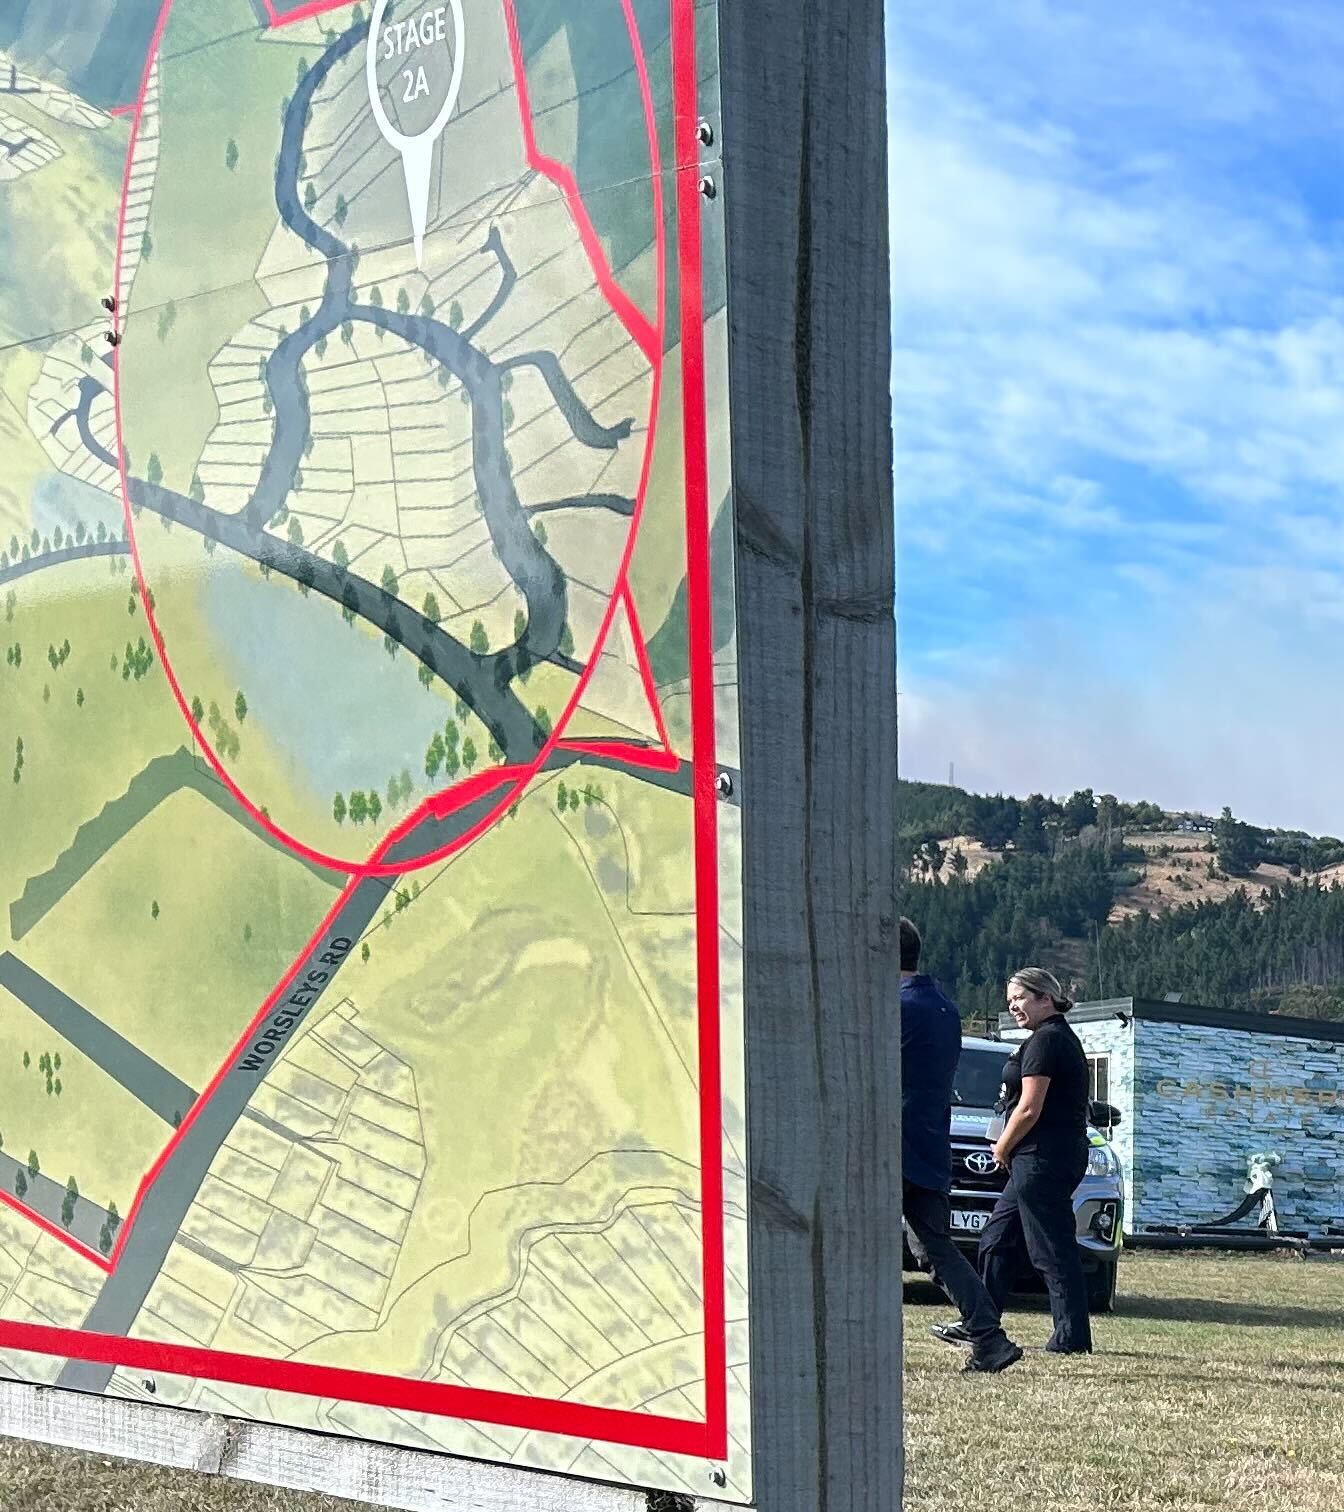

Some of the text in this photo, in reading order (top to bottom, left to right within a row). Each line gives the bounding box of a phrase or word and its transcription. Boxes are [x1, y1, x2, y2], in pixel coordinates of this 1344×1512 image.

[383, 7, 446, 60] STAGE
[402, 66, 430, 103] 2A
[238, 937, 352, 1072] WORSLEYS RD
[950, 1212, 991, 1228] LYG7
